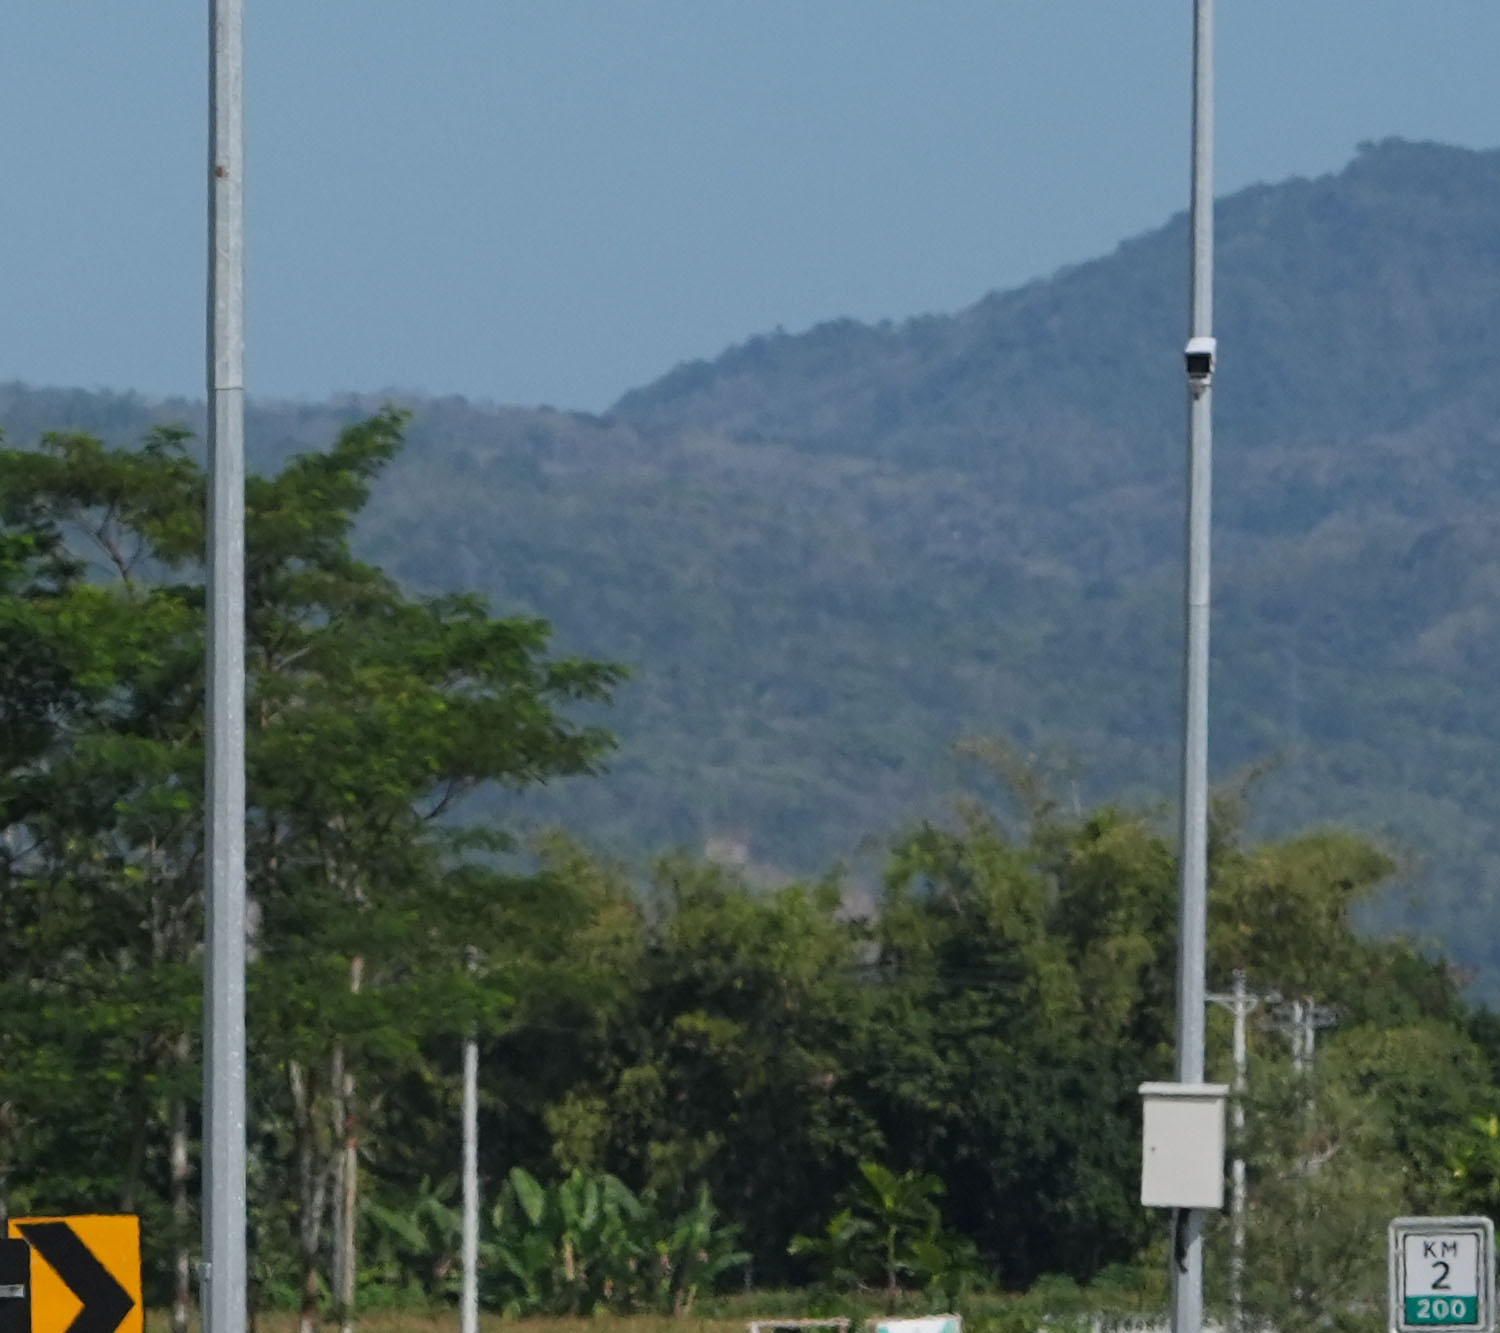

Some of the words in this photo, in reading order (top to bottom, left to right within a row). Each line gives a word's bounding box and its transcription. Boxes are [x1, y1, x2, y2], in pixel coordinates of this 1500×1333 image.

[1423, 1241, 1458, 1258] KM
[1431, 1261, 1452, 1290] 2
[1416, 1299, 1467, 1320] 200
